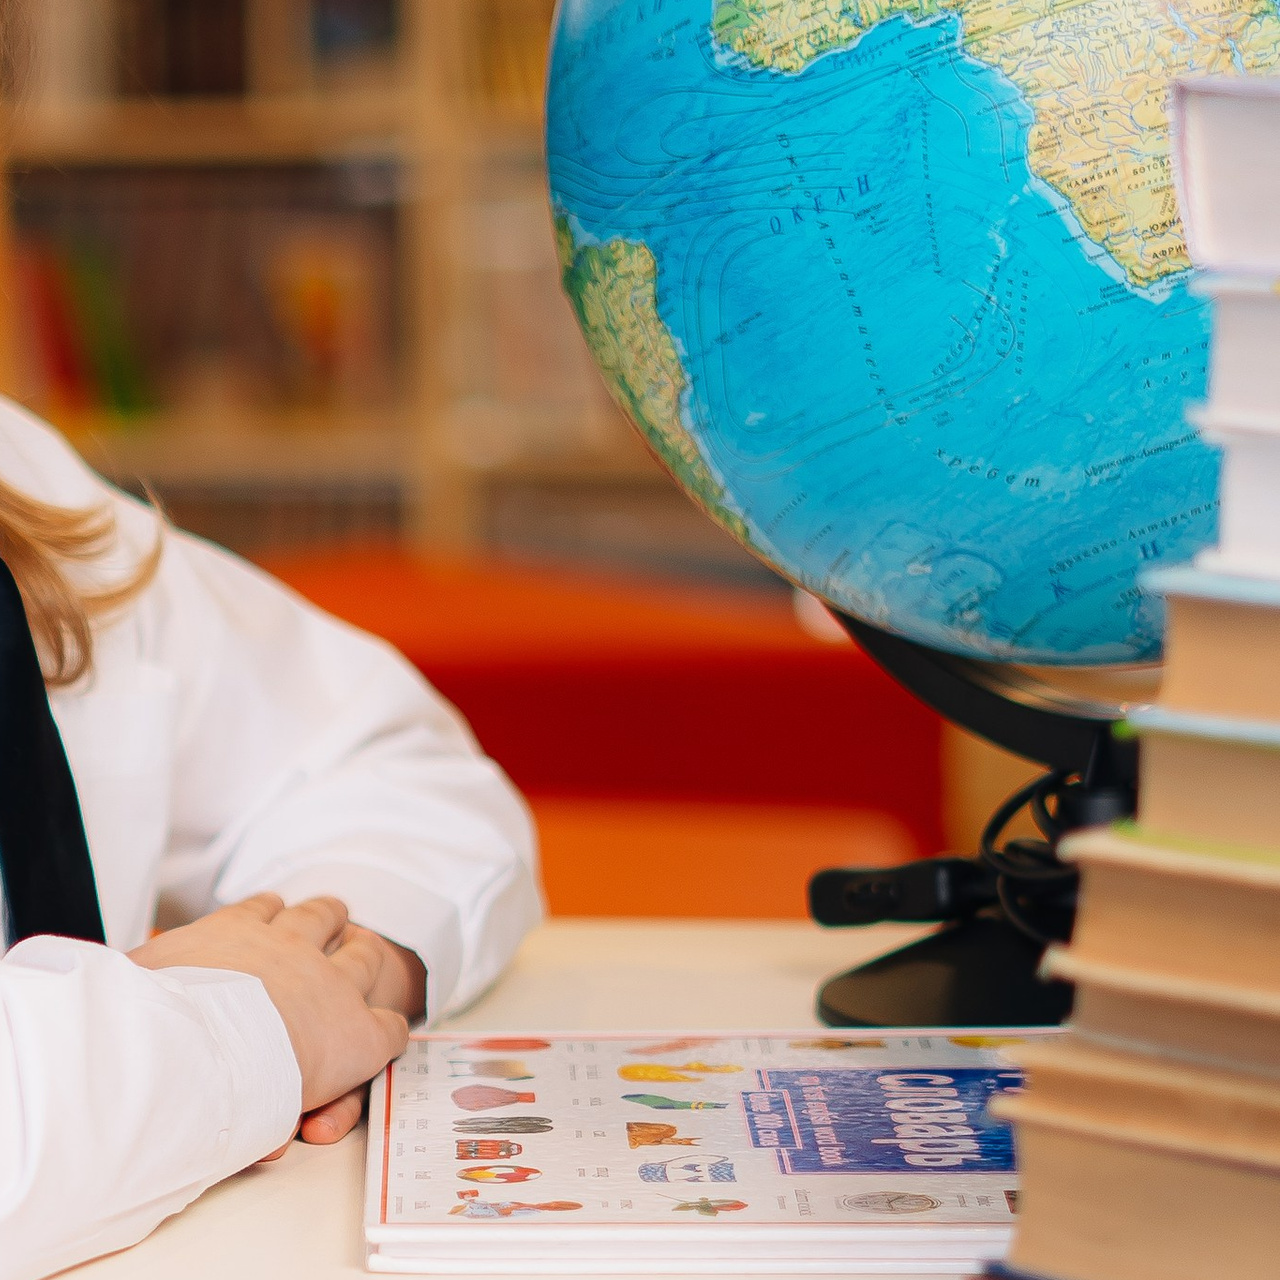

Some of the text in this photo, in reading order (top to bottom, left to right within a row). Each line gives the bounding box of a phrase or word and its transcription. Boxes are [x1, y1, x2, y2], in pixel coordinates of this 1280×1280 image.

[1131, 160, 1172, 176] БОТСВА
[1066, 168, 1120, 190] НАМИБИЯ
[769, 173, 870, 236] ОКЕАН
[1150, 216, 1182, 232] ЮЖНА
[1152, 244, 1188, 259] АФРИК
[1123, 341, 1209, 370] котло
[1143, 366, 1206, 389] Агул
[933, 447, 1041, 488] хребет
[801, 1085, 831, 1101] first
[871, 1073, 982, 1167] словарь
[757, 1128, 780, 1147] слов
[814, 1126, 846, 1145] word
[817, 1146, 848, 1166] book
